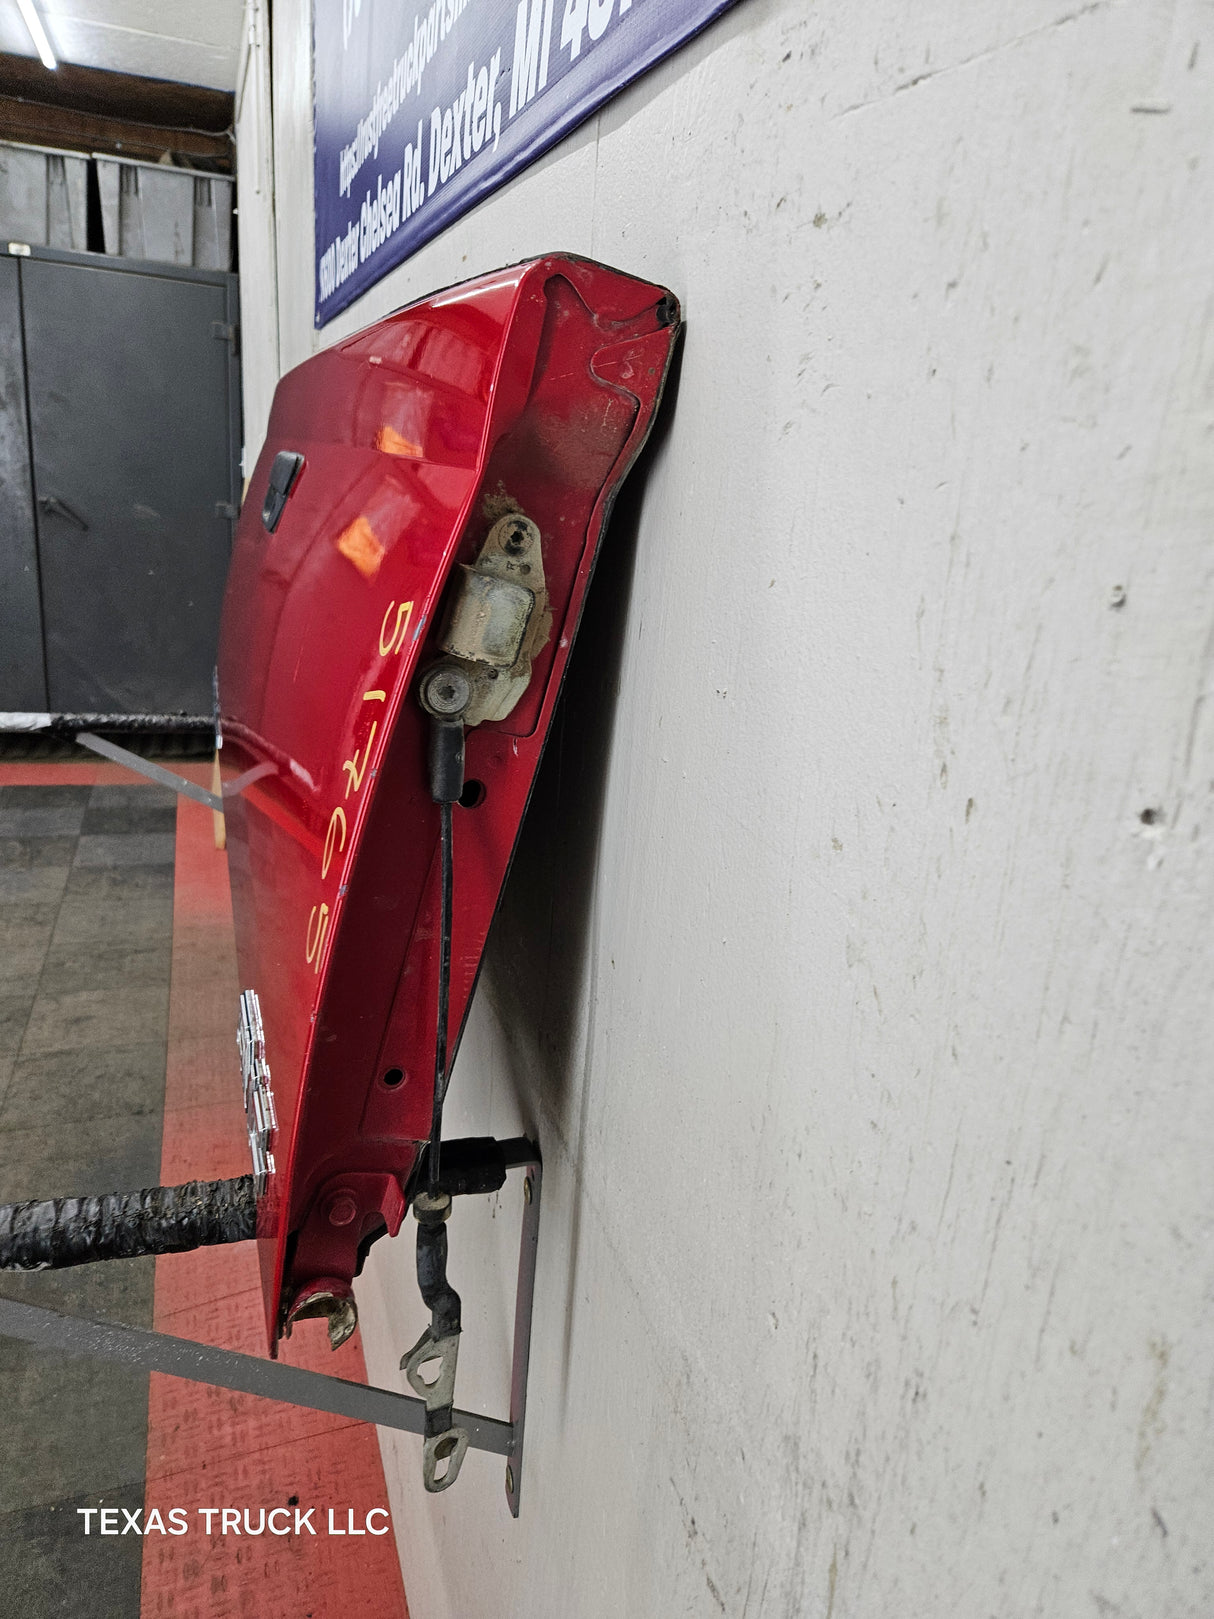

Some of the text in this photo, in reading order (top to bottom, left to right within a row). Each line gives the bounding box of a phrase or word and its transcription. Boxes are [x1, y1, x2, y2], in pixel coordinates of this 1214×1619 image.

[360, 170, 401, 264] Chelsea
[401, 118, 425, 223] Rd.
[427, 46, 502, 198] Dexter,
[508, 0, 554, 120] MI
[306, 600, 414, 975] 51765
